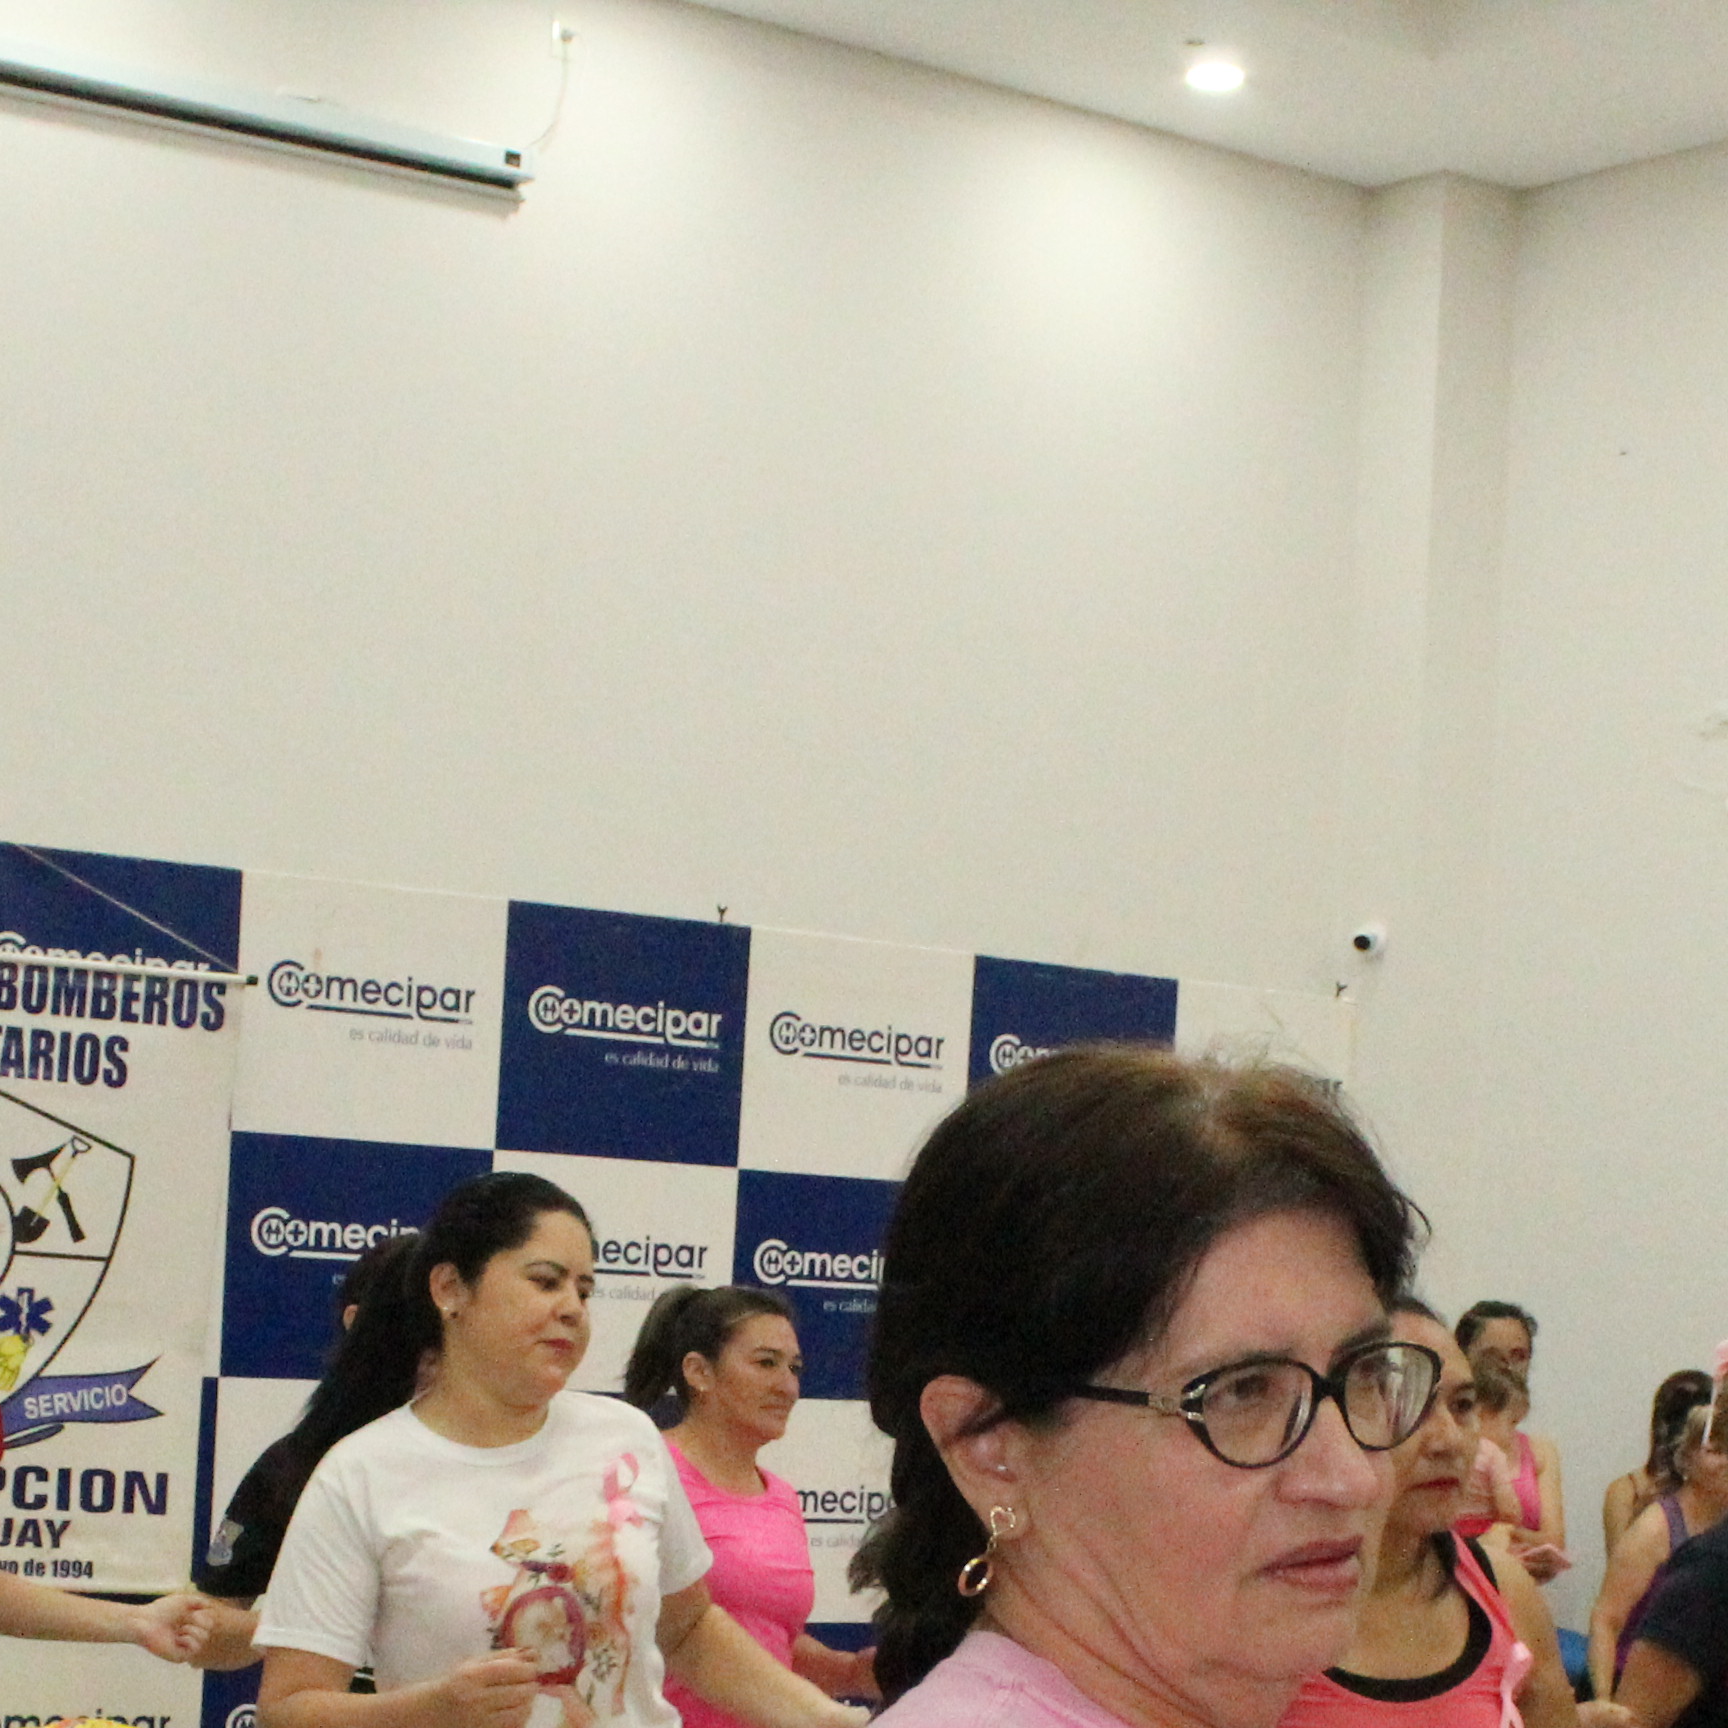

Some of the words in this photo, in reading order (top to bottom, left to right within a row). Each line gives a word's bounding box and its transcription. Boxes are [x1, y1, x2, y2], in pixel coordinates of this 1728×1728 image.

[267, 959, 476, 1023] Comecipar
[528, 984, 723, 1048] Comecipar
[349, 1027, 364, 1040] es
[368, 1027, 419, 1046] calidad
[423, 1032, 440, 1048] de
[444, 1034, 473, 1050] vida
[769, 1011, 945, 1068] Comecipar
[604, 1052, 619, 1065] es
[622, 1050, 669, 1069] calidad
[672, 1054, 690, 1070] de
[692, 1057, 720, 1073] vida
[854, 1073, 896, 1089] calidad
[917, 1078, 942, 1094] vida
[24, 1384, 130, 1420] SERVICIO
[23, 1559, 45, 1577] de
[51, 1560, 93, 1579] 1994
